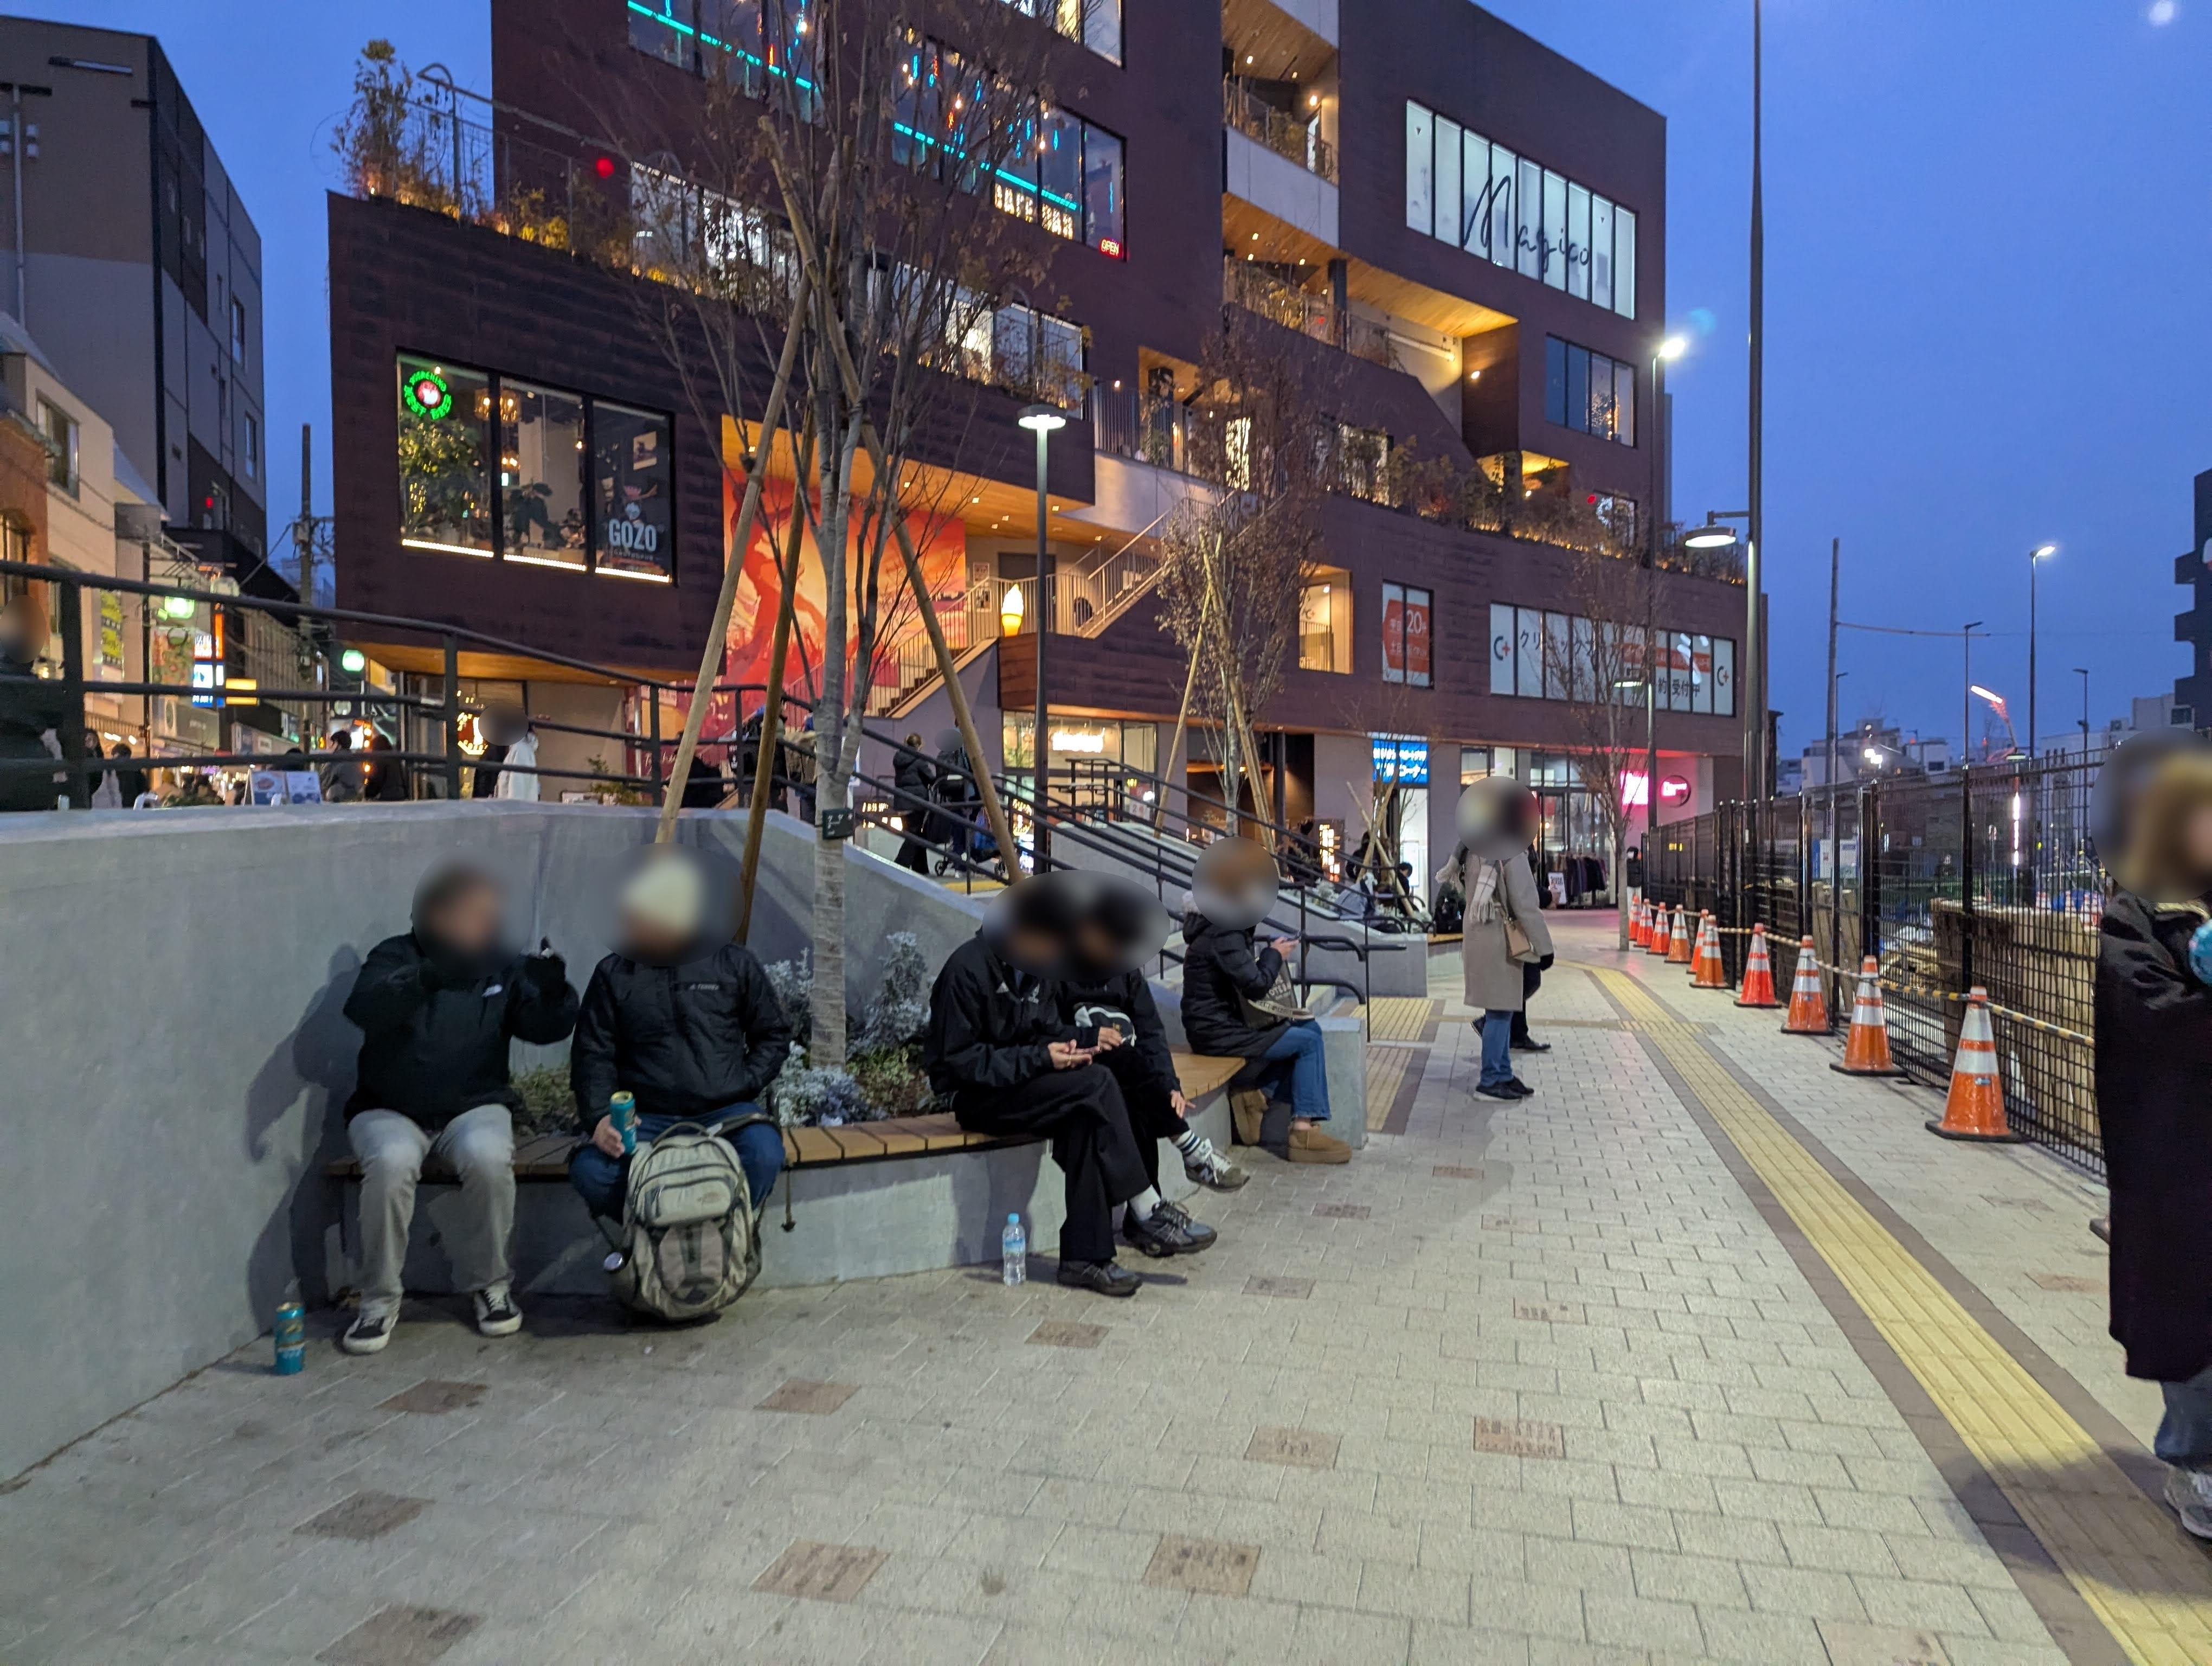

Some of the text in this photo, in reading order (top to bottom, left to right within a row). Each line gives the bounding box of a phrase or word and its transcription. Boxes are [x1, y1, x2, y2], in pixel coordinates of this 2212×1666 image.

[1464, 175, 1589, 273] Magico
[1101, 239, 1119, 257] OPEN
[609, 518, 657, 552] GOZO
[1657, 677, 1701, 698] 約受付中
